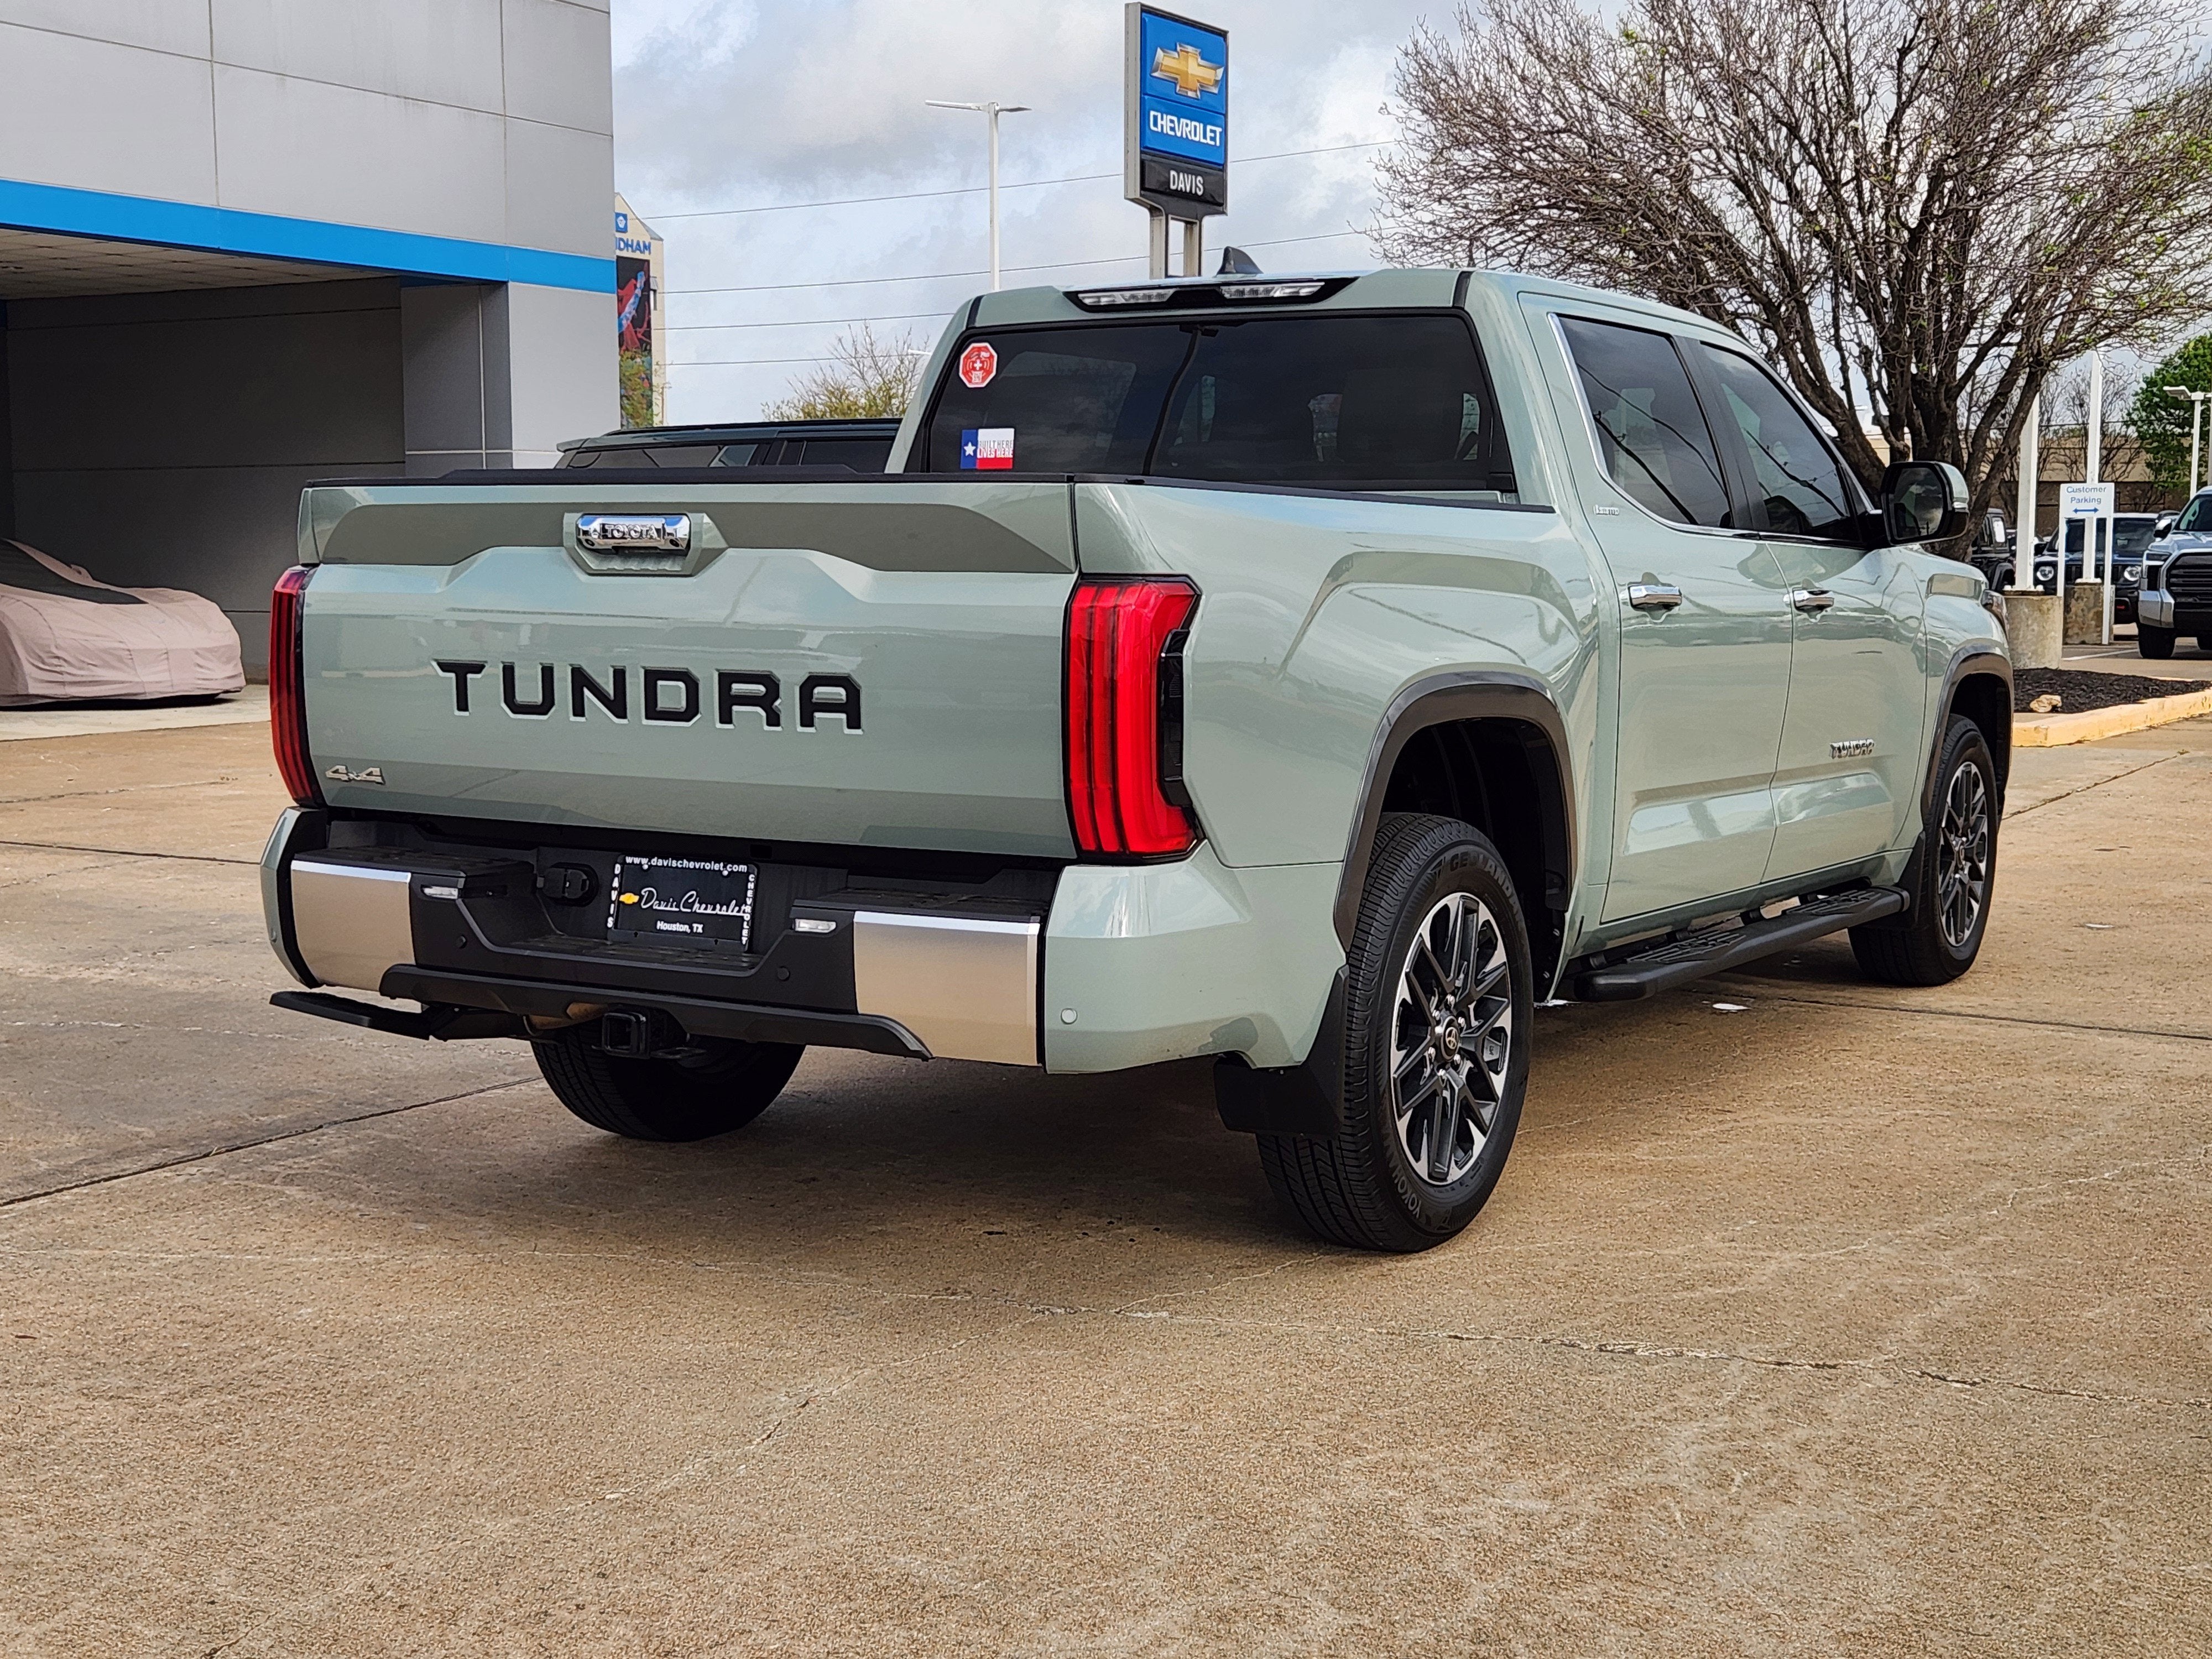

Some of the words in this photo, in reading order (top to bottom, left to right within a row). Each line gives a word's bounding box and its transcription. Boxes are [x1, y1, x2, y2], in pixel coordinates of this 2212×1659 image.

[1150, 110, 1222, 147] CHEVROLET
[1170, 169, 1203, 196] DAVIS
[2070, 497, 2102, 505] Parking
[604, 523, 659, 539] TOYOTA
[430, 658, 864, 734] TUNDRA
[625, 855, 748, 873] www.davischevrolet.com
[607, 863, 621, 928] DAVIS
[640, 887, 680, 911] Davis
[680, 890, 749, 917] Chevrolet
[741, 874, 756, 945] CHEVROLET
[656, 920, 691, 933] Houston,
[692, 923, 703, 933] TX
